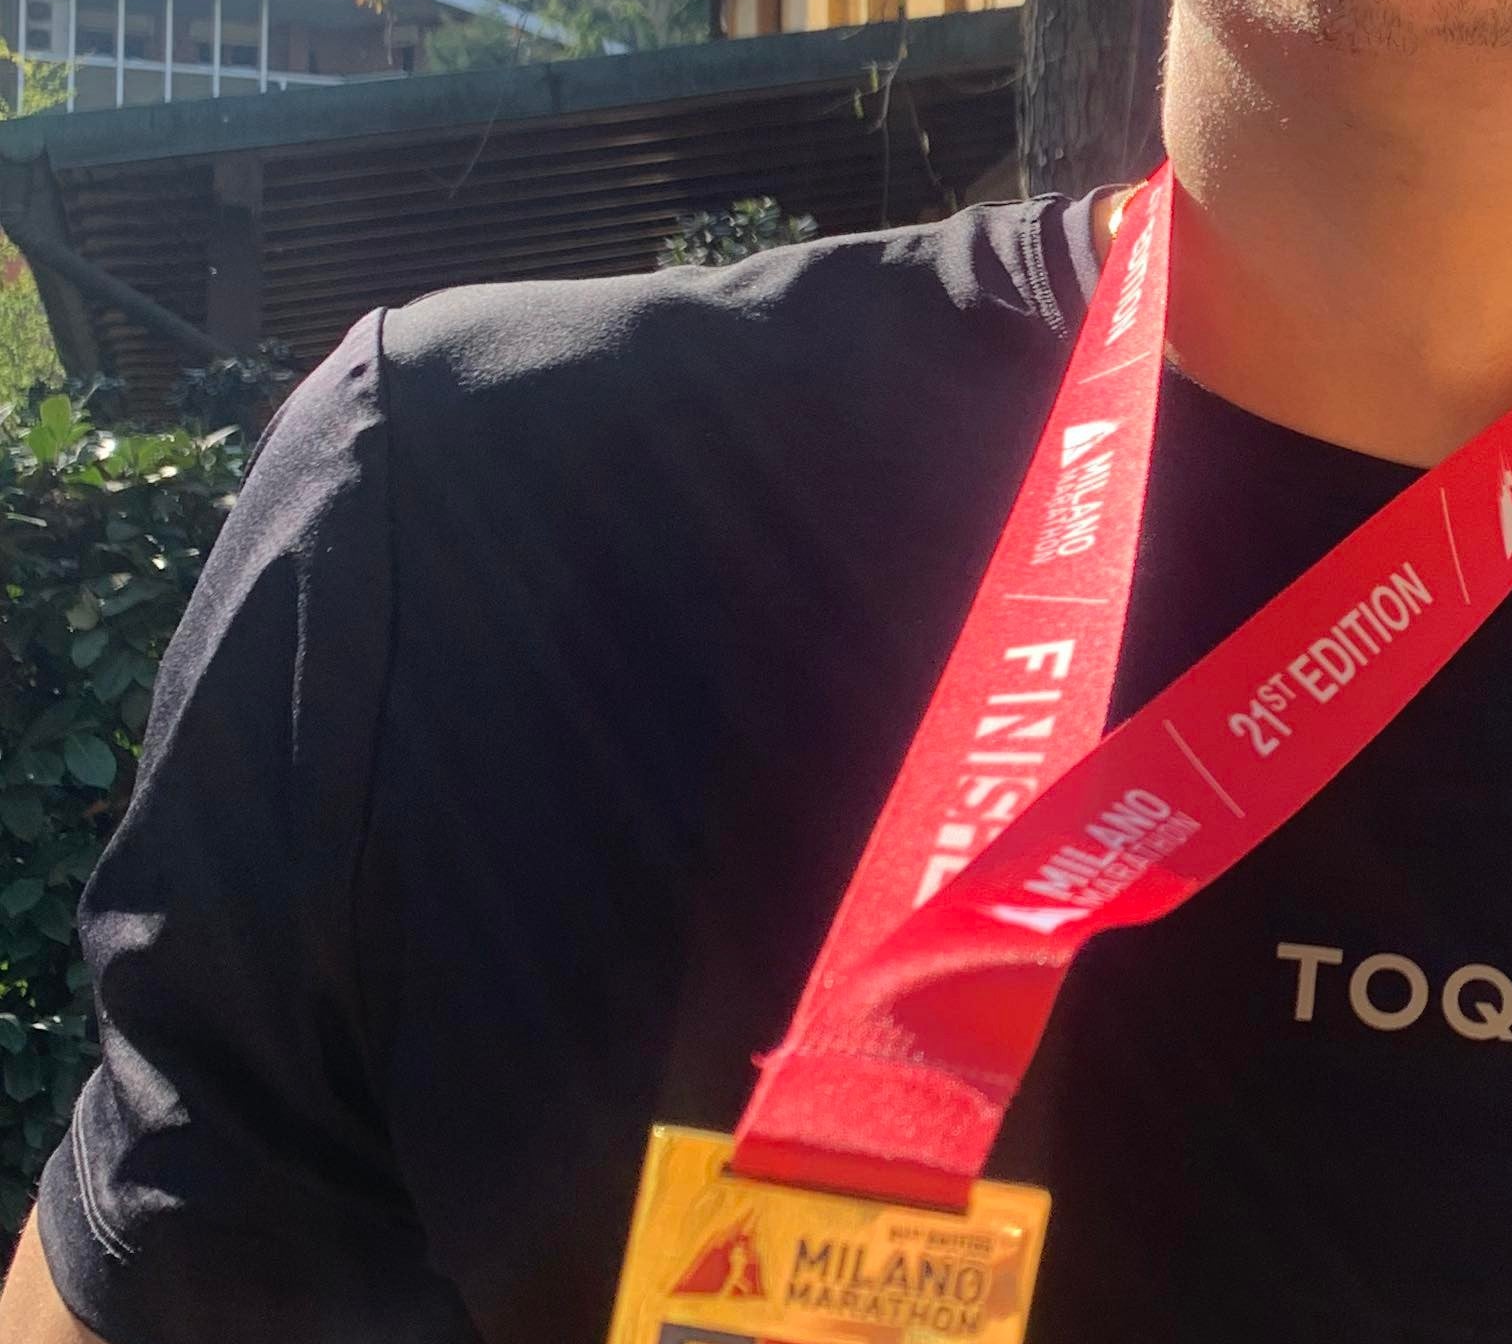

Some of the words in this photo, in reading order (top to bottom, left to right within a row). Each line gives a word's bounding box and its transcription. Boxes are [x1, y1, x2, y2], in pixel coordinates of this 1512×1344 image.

[1057, 451, 1115, 555] MILANO
[1228, 673, 1297, 756] 21ST
[1287, 561, 1433, 703] EDITION
[1024, 788, 1171, 902] MILANO
[785, 1281, 984, 1335] MARATHON
[791, 1238, 986, 1306] MILANO
